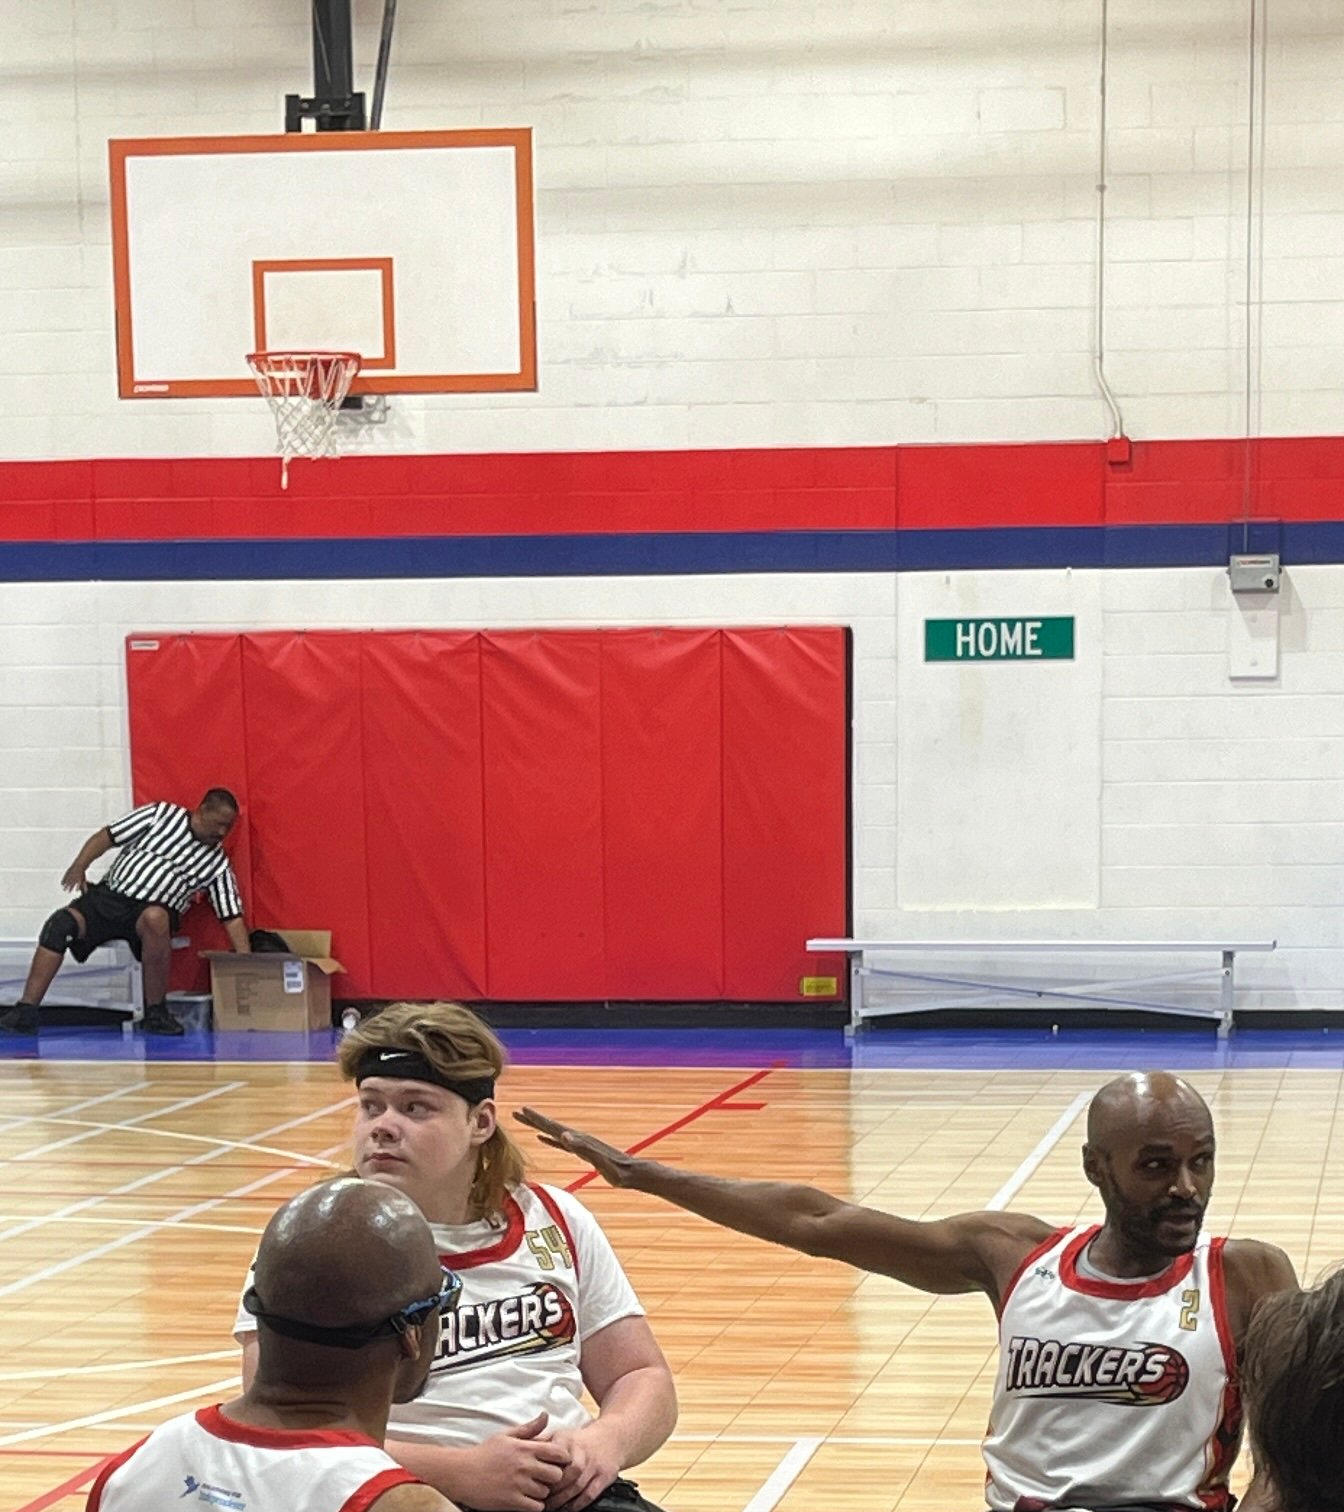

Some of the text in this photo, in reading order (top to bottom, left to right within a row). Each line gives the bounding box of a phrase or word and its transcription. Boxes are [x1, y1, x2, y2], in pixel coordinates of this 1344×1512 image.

[956, 622, 1042, 657] HOME
[525, 1225, 573, 1271] 54
[1178, 1288, 1200, 1332] 2
[1006, 1335, 1172, 1392] TRACKERS
